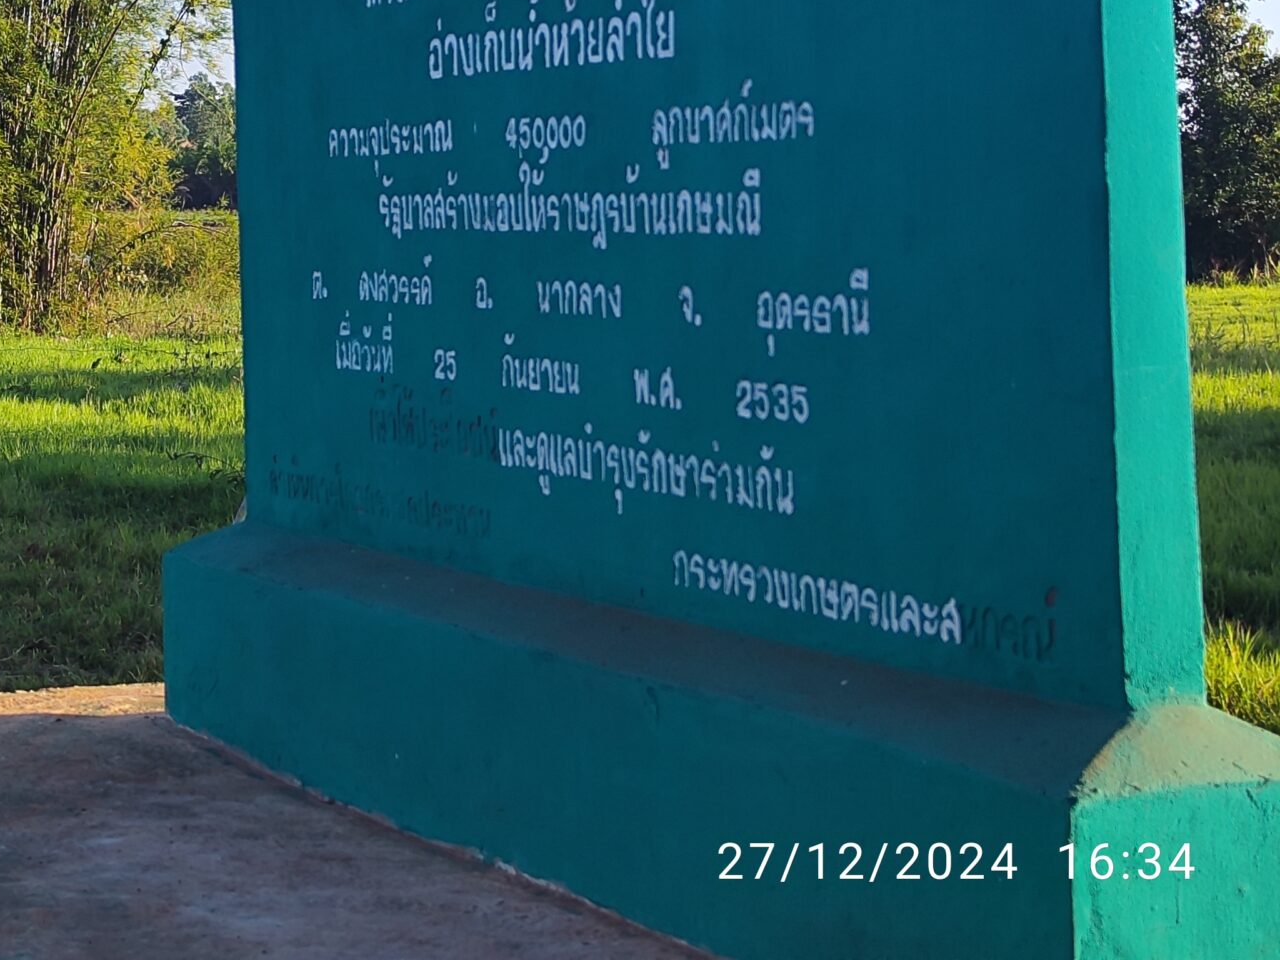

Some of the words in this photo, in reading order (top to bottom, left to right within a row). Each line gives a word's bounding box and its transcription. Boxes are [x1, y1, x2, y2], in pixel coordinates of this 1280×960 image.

[328, 118, 454, 177] ความจุประมาณ
[504, 114, 586, 164] 450,000
[651, 78, 815, 170] ลูกบาศก์เมตร
[312, 270, 328, 300] ต.
[358, 254, 433, 306] ดงสวรรค์
[536, 279, 622, 319] นากลาง
[678, 285, 702, 327] จ.
[756, 267, 870, 357] อุดรธานี
[335, 309, 394, 374] เมื่อวันที่
[433, 348, 457, 381] 25
[501, 333, 581, 395] กันยายน
[633, 366, 683, 411] พ.ศ.
[735, 379, 810, 424] 2535
